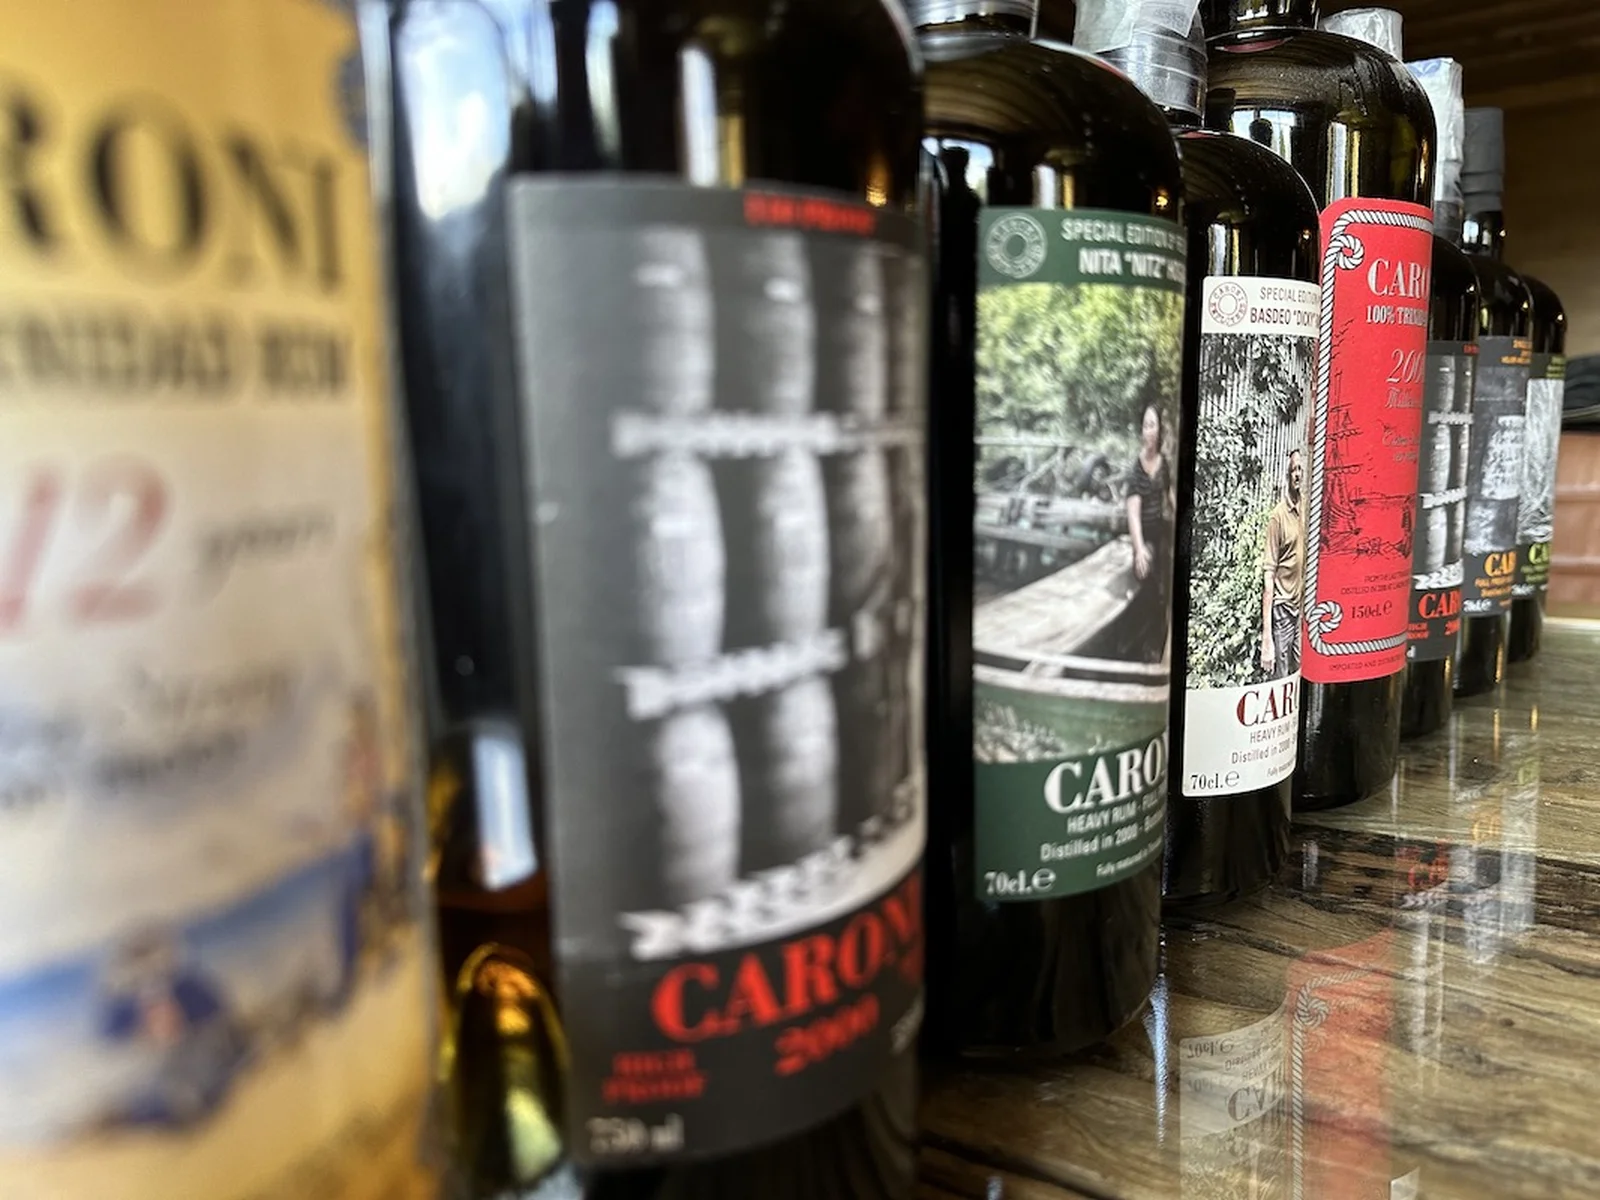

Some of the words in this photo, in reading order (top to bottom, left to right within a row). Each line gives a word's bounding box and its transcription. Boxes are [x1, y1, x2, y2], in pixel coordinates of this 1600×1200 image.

[1060, 218, 1126, 244] SPECIAL
[1078, 247, 1123, 275] NITA
[1260, 286, 1297, 302] SPECIAL
[1250, 307, 1292, 325] BASDEO
[1366, 305, 1395, 325] 100%
[1250, 727, 1276, 743] HEAVY
[1231, 746, 1269, 764] Distilled
[1067, 810, 1110, 835] HEAVY
[1040, 835, 1099, 862] Distilled
[1101, 834, 1114, 850] in
